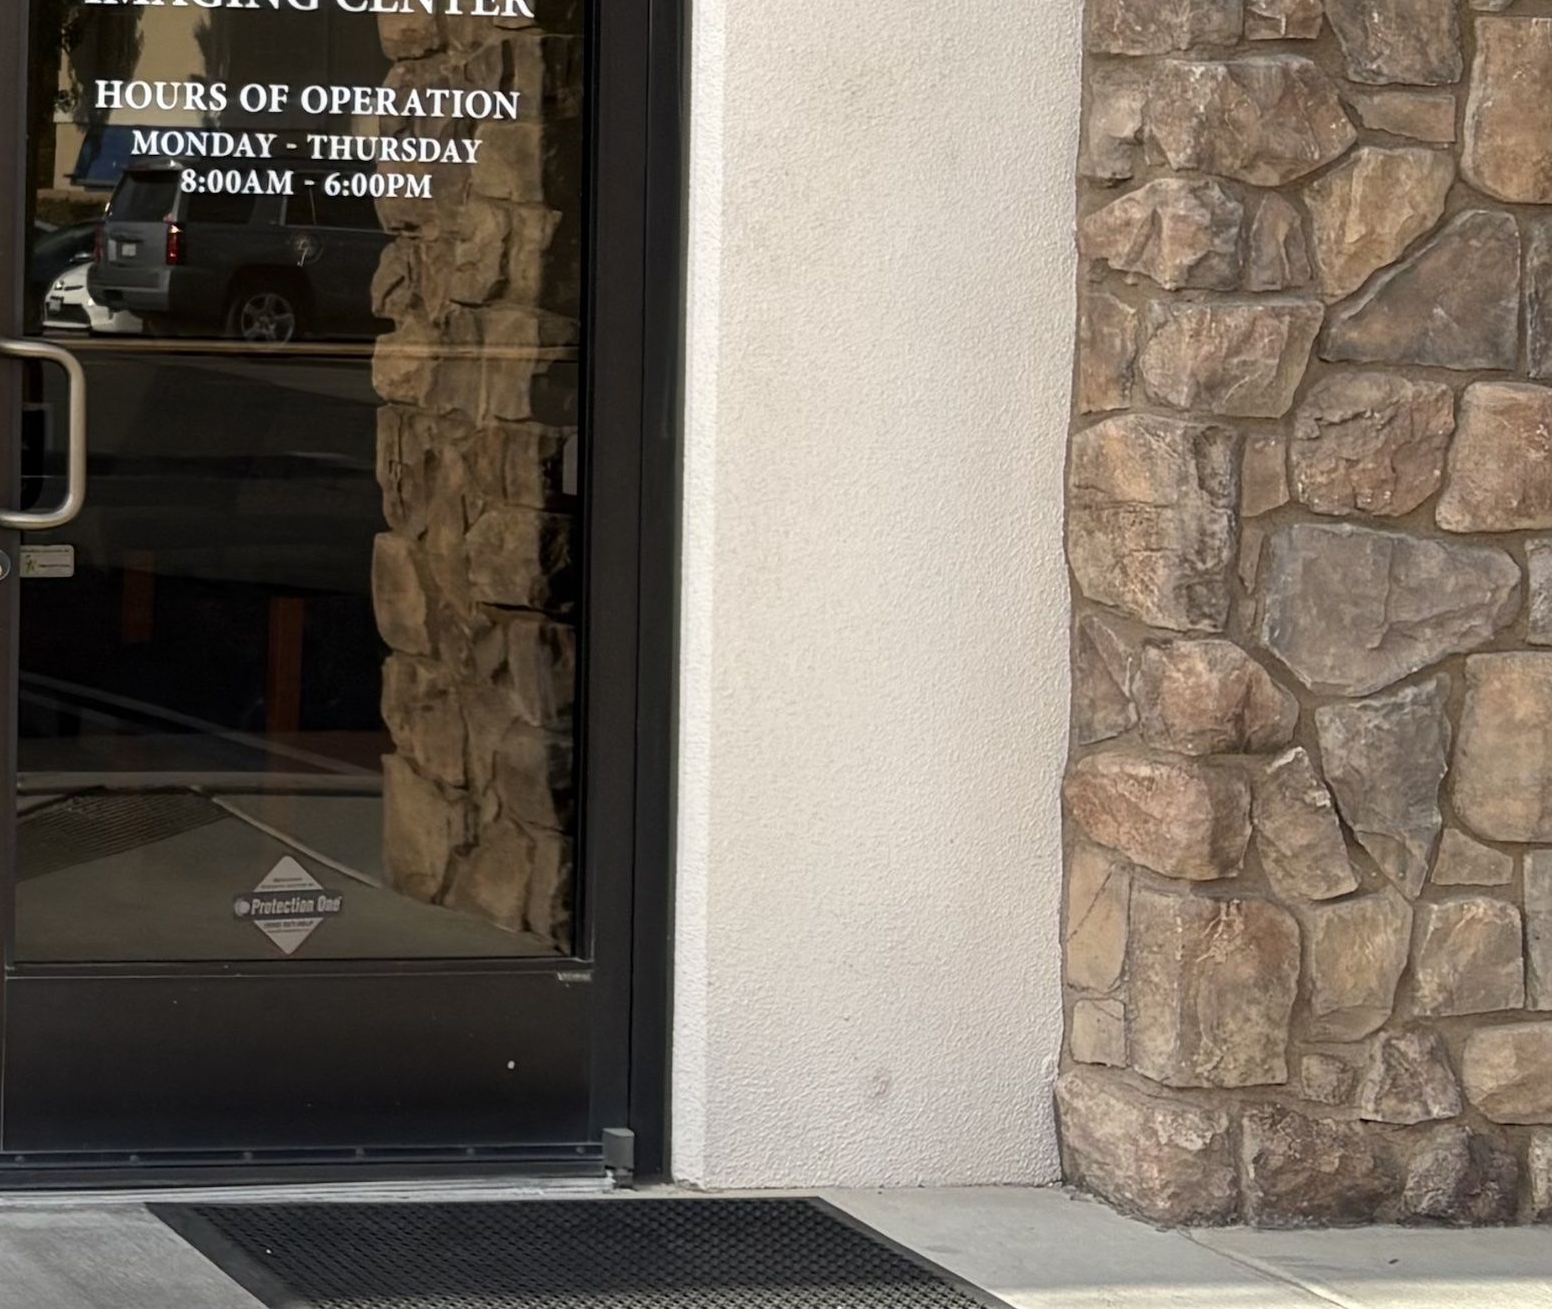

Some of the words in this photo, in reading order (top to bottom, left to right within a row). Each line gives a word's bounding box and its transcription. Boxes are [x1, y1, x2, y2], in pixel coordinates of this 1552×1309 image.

[95, 80, 227, 112] HOURS
[239, 83, 289, 113] OF
[301, 85, 520, 120] OPERATION
[131, 130, 277, 158] MONDAY
[307, 134, 483, 164] THURSDAY
[180, 168, 294, 195] 8:00AM
[324, 172, 432, 199] 6:00PM
[251, 897, 314, 915] Protection
[317, 895, 340, 912] One
